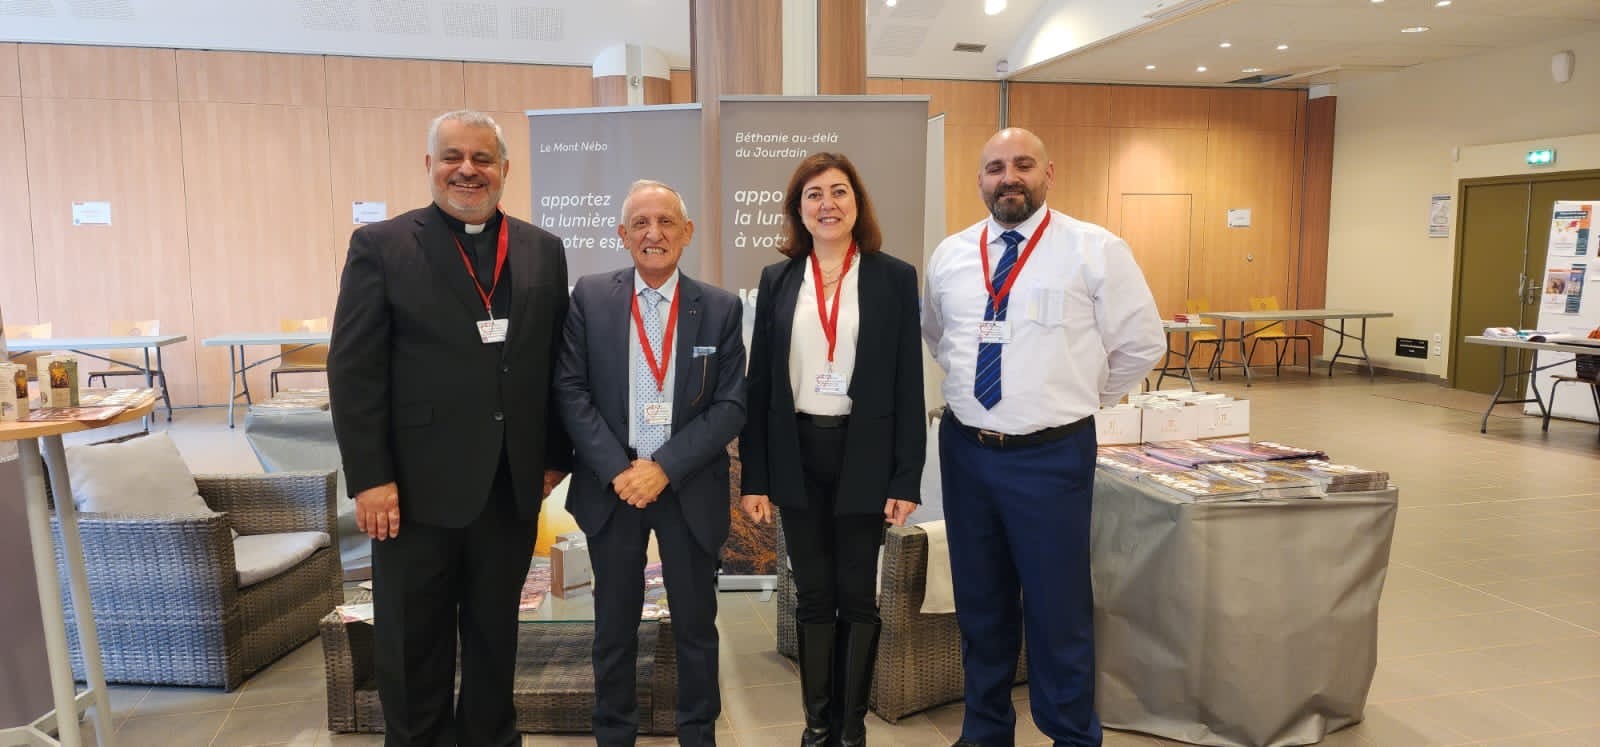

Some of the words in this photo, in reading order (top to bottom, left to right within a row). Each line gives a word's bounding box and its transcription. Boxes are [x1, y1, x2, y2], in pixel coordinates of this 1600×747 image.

[735, 131, 789, 144] Béthanie
[791, 131, 838, 144] au-delà
[540, 143, 551, 153] Le
[553, 142, 579, 153] Mont
[581, 141, 608, 152] Nébo
[735, 147, 750, 159] du
[753, 147, 807, 159] Jourdain
[541, 193, 611, 209] apportez
[734, 190, 783, 205] appo
[541, 213, 555, 228] la
[558, 212, 616, 228] lumière
[734, 209, 752, 225] la
[563, 235, 594, 248] otre
[600, 238, 625, 251] esp
[734, 231, 748, 248] à
